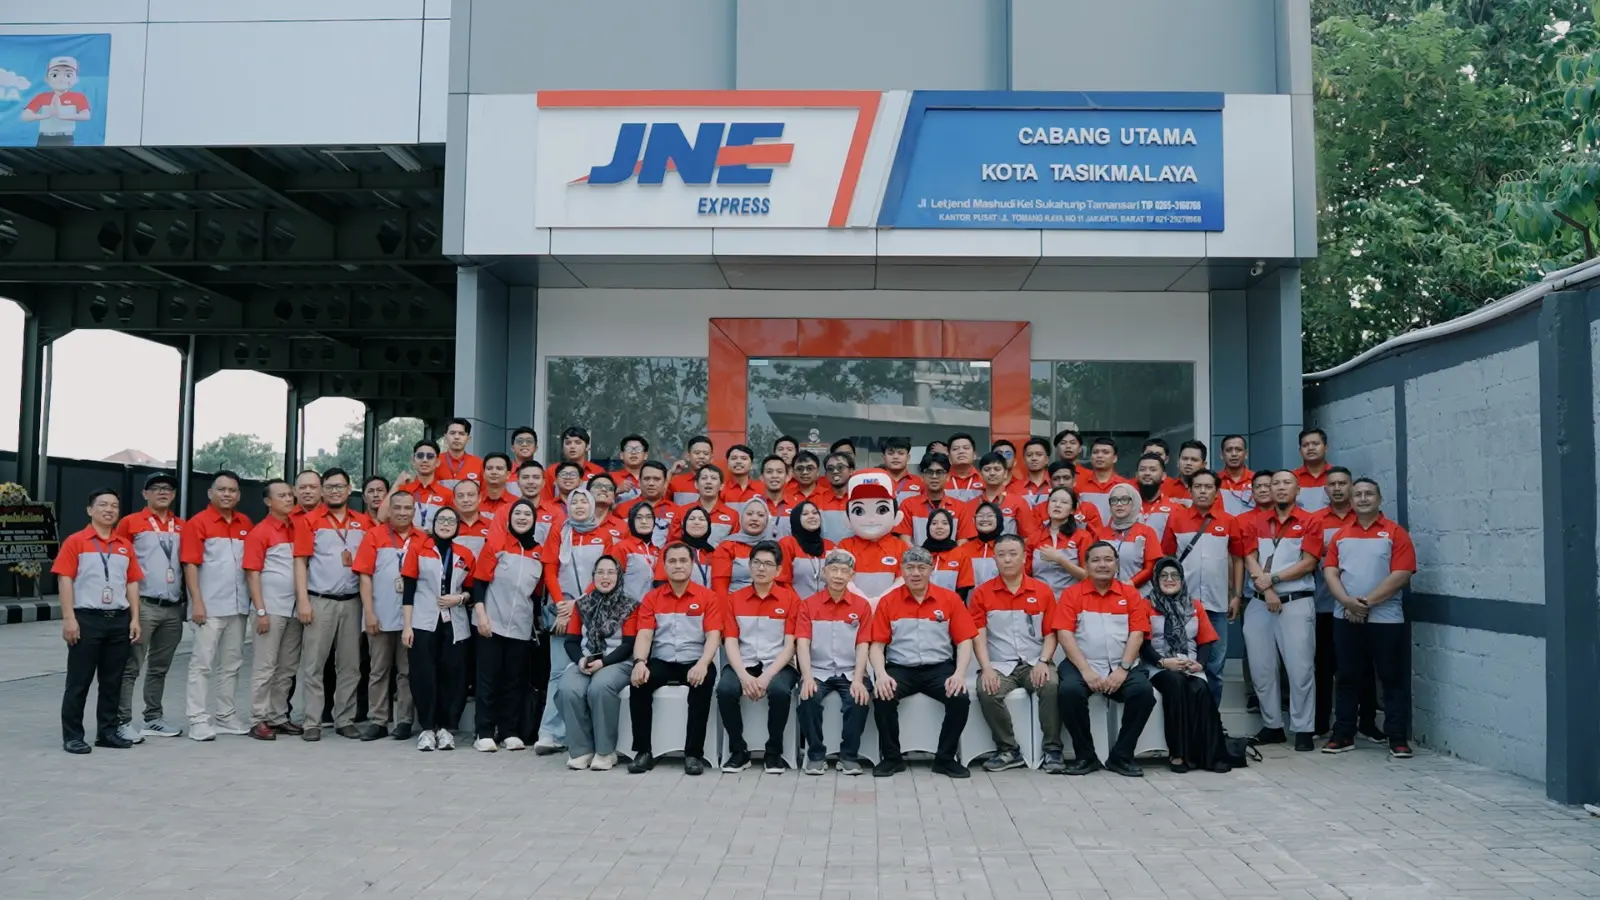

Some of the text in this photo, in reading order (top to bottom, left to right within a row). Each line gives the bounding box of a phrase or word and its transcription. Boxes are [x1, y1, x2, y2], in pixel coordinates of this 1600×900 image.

[1018, 126, 1198, 147] CABANG UTAMA
[587, 122, 795, 184] JNE
[981, 163, 1199, 184] KOTA TASIKMALAYA
[697, 197, 770, 215] EXPRESS
[931, 198, 971, 210] Letjend
[973, 198, 1016, 209] Mashudi
[1017, 199, 1033, 208] Kel
[1035, 199, 1087, 211] Sukahurip
[1087, 199, 1140, 210] Tamansari
[938, 213, 971, 221] KANTOR
[973, 213, 998, 221] PUSAT
[1012, 214, 1043, 222] TOMANG
[1044, 214, 1064, 222] RAYA
[1120, 215, 1144, 223] BARAT
